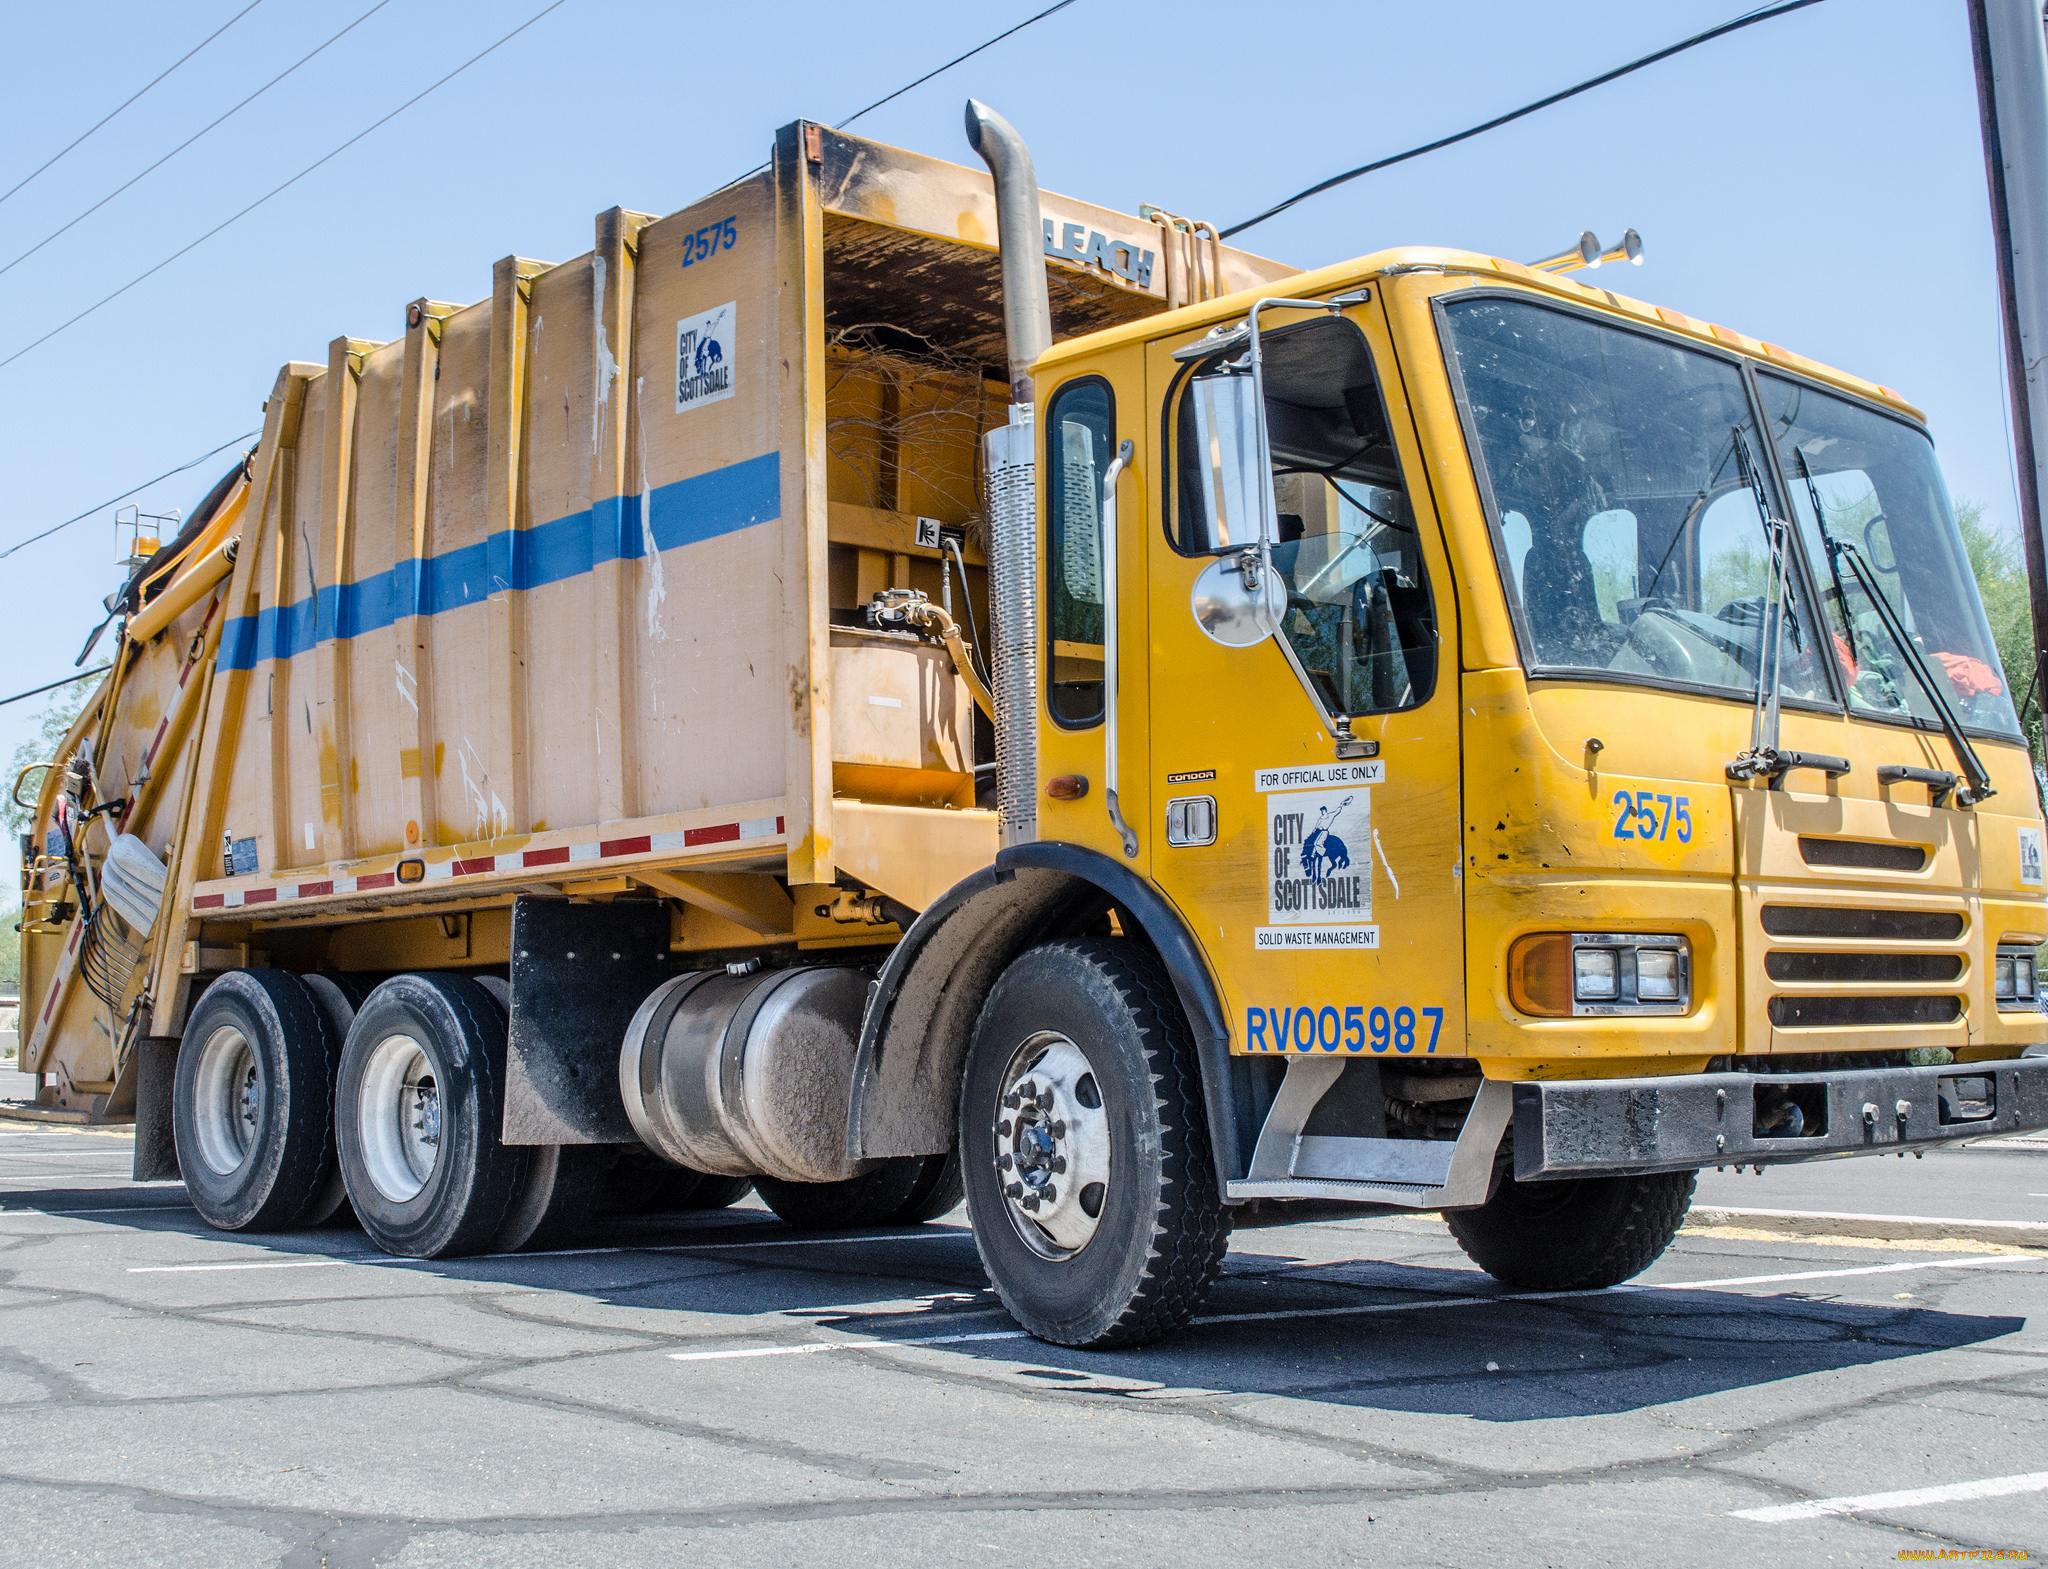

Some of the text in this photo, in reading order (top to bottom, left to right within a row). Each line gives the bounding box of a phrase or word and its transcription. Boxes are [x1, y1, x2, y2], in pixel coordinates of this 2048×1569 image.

[682, 215, 737, 268] 2575
[1043, 218, 1155, 288] LEACH
[680, 329, 698, 356] CITY
[680, 356, 689, 380] OF
[679, 366, 728, 404] SCOTTSDALE
[1168, 771, 1214, 782] CONDOR
[1260, 765, 1378, 787] FOR OFFICIAL USE ONLY
[1274, 813, 1304, 846] CITY
[1613, 790, 1692, 844] 2575
[1274, 847, 1290, 879] OF
[1275, 876, 1361, 911] SCOTTSDALE
[1258, 931, 1375, 945] SOLID WASTE MANAGEMENT
